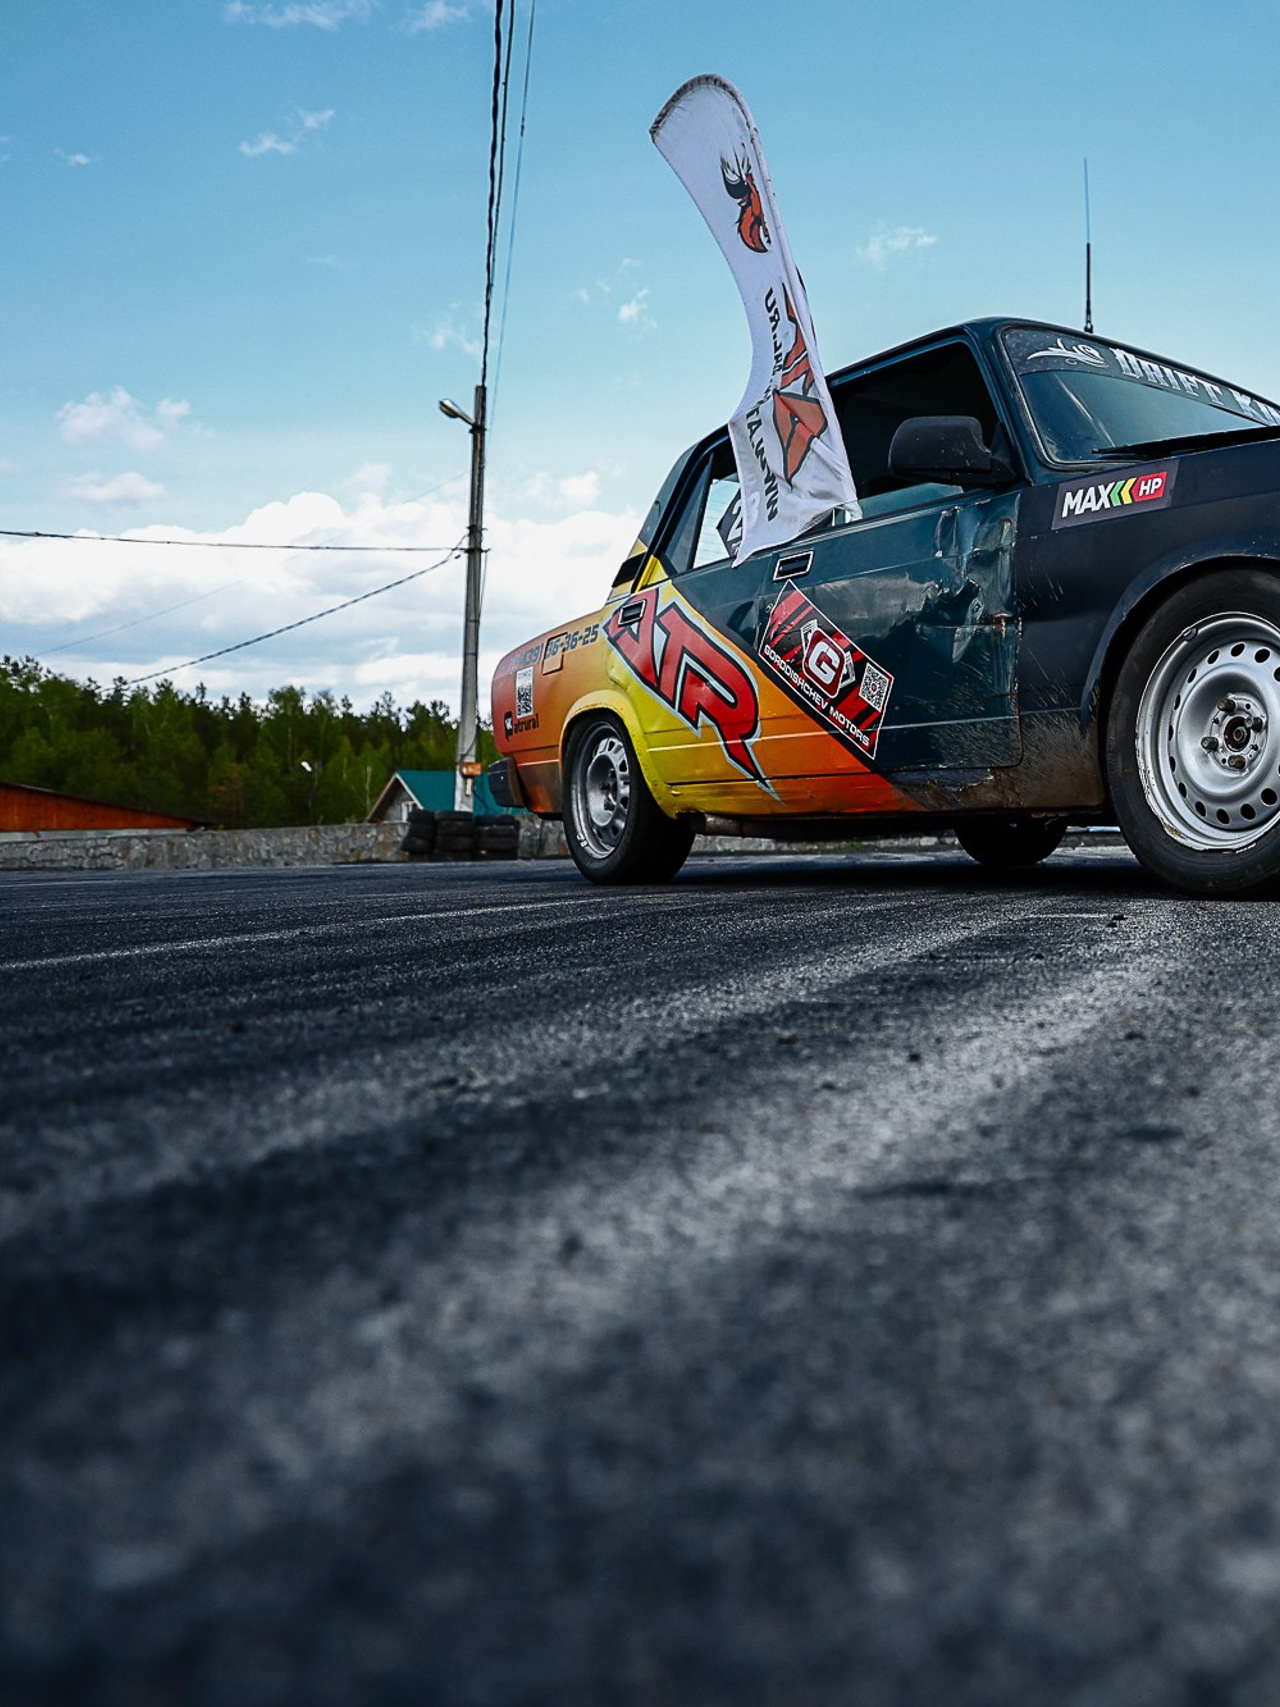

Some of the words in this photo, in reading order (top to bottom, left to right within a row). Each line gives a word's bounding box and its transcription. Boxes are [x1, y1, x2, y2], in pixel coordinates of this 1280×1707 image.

[1109, 346, 1226, 406] DRIFT
[1061, 481, 1116, 519] MAX
[1138, 477, 1163, 497] HP
[546, 623, 600, 659] 36-36-25
[763, 643, 829, 710] GORODISHCHEV
[829, 705, 871, 748] MOTORS
